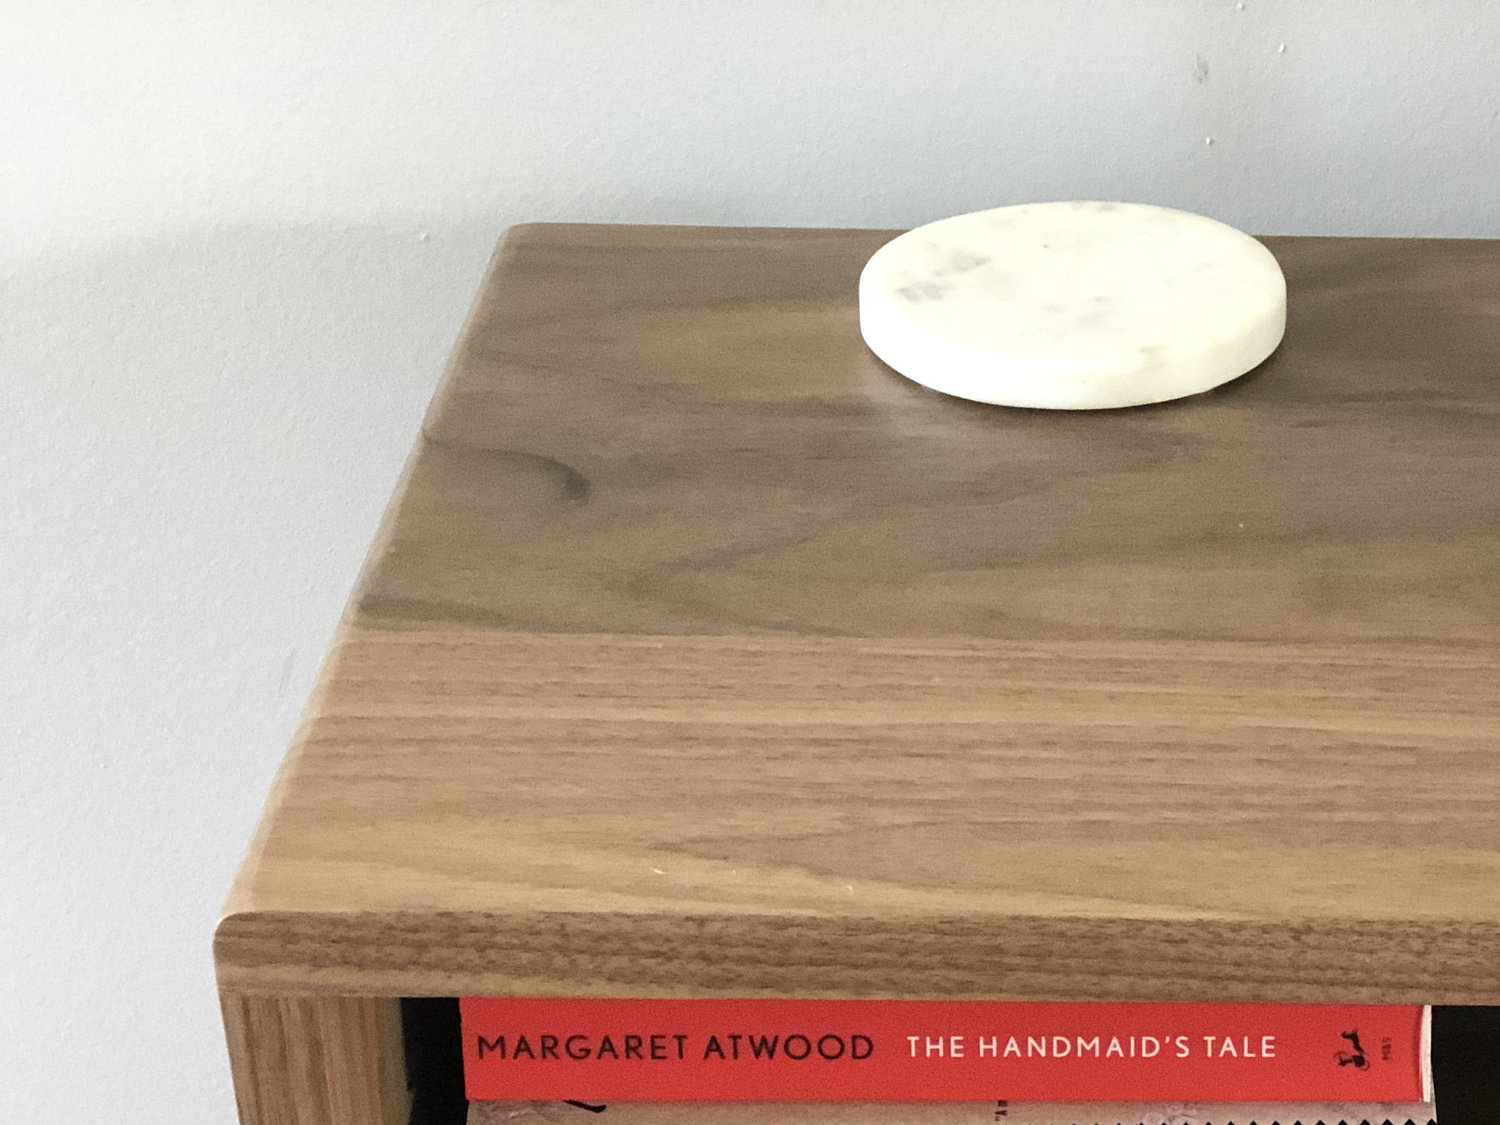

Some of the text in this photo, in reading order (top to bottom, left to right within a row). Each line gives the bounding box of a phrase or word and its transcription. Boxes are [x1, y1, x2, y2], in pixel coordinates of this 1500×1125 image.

[477, 1034, 875, 1060] MARGARET ATWOOD
[907, 1035, 1277, 1058] THE HANDMAID'S TALE
